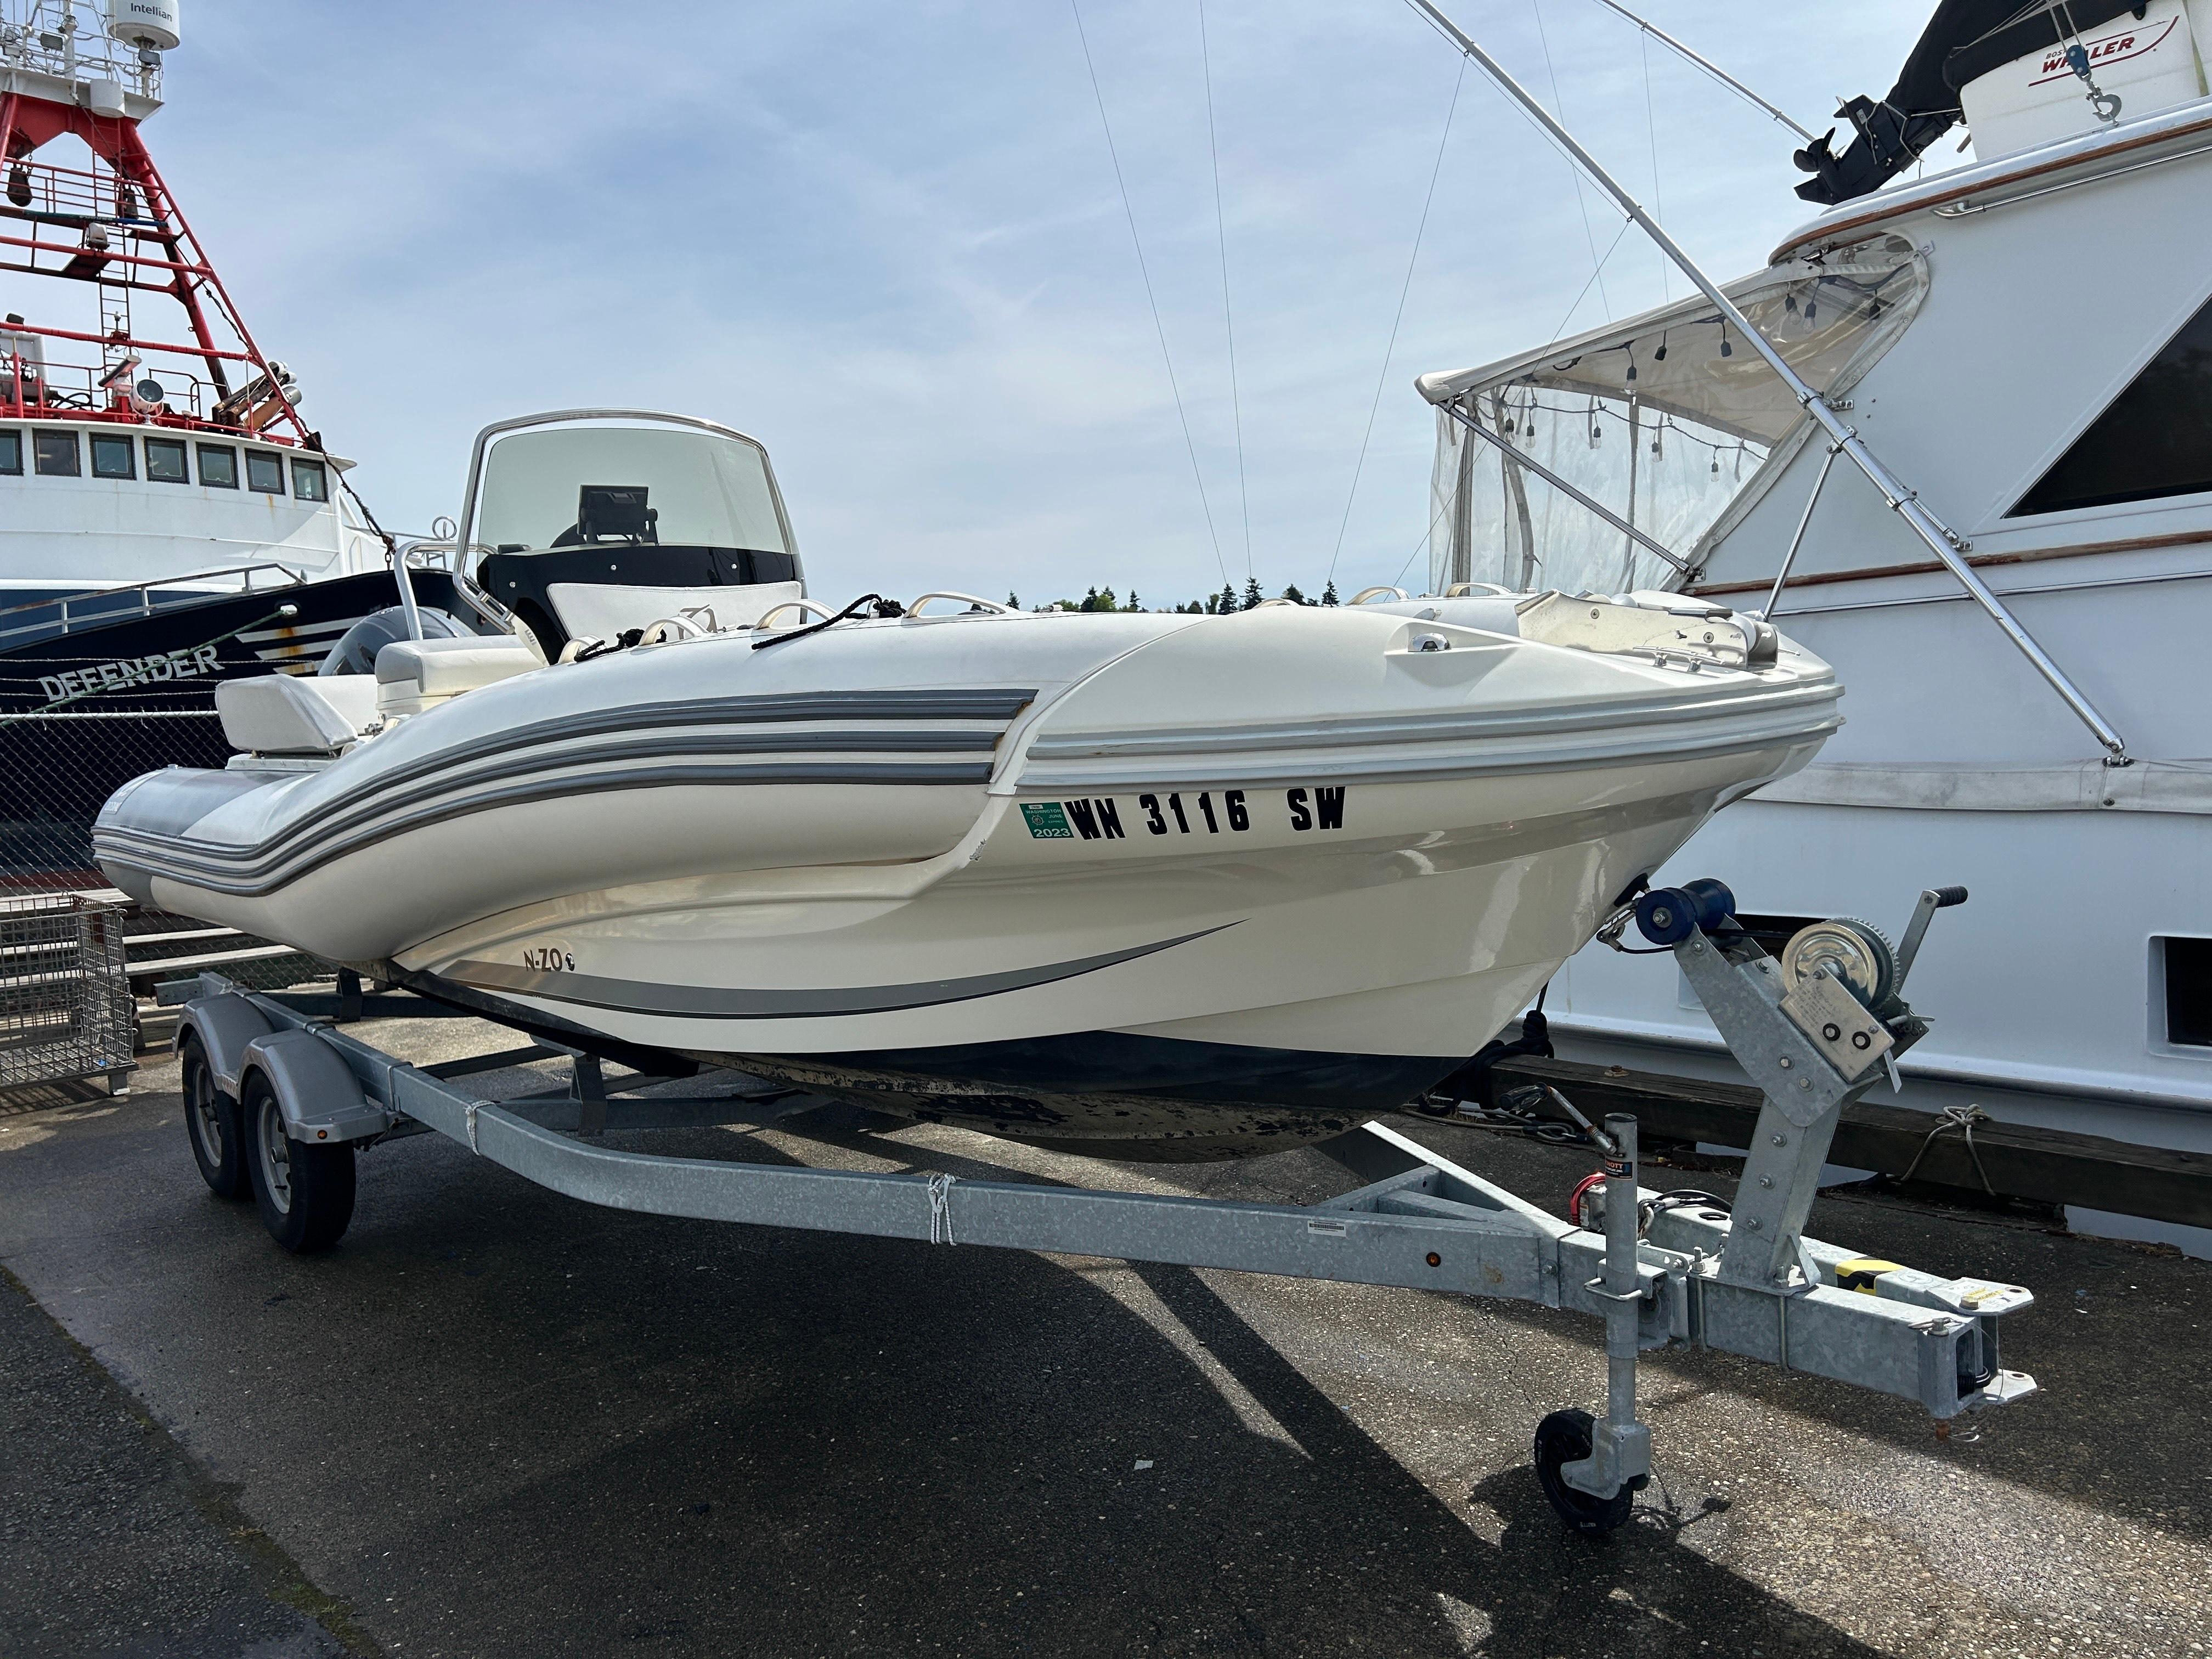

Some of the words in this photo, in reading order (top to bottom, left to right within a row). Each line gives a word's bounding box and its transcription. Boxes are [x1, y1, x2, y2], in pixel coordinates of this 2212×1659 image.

[131, 3, 172, 22] Intellian
[2042, 37, 2135, 73] WHLER
[38, 645, 225, 702] DEFENDER
[1064, 798, 1126, 840] WN
[1139, 789, 1250, 836] 3116
[1286, 786, 1346, 831] SW
[1034, 828, 1071, 837] 2023
